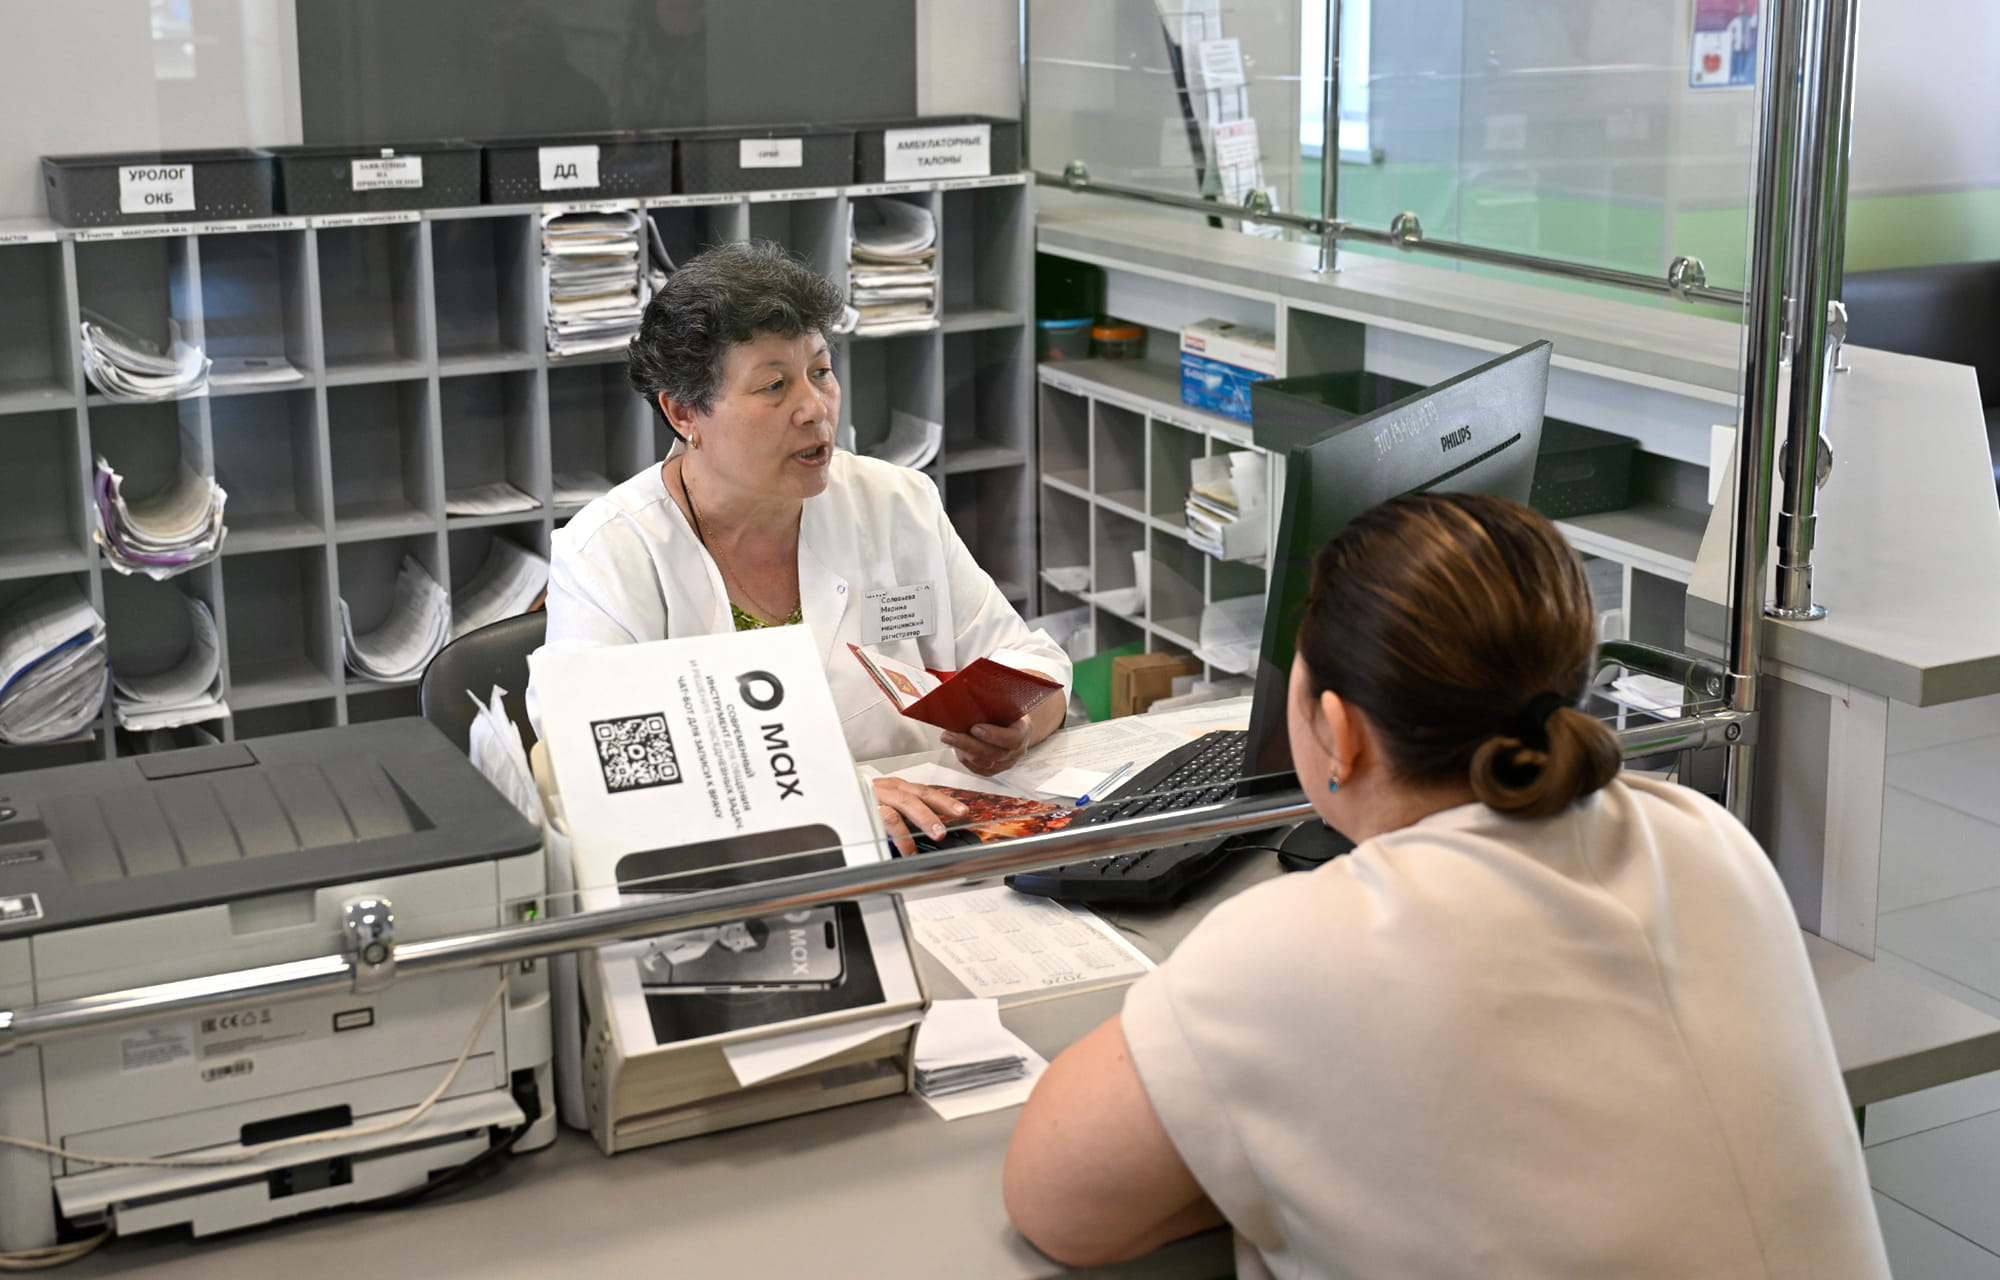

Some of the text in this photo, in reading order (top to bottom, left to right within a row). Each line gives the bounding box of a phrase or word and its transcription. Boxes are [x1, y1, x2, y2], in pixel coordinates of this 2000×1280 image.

[897, 137, 981, 150] АМБУЛАТОРНЫЕ
[918, 156, 962, 166] ТАЛОНЫ
[129, 168, 186, 181] УРОЛОГ
[554, 163, 578, 179] ДД
[144, 193, 174, 205] ОКБ
[1440, 425, 1472, 453] PHILIPS
[880, 605, 907, 613] Марина
[881, 613, 915, 623] Борисовна
[881, 619, 924, 632] медицинский
[881, 630, 921, 641] регистратор
[677, 675, 694, 715] ЧАТ-БОТ
[686, 716, 701, 737] ДЛЯ
[694, 739, 712, 780] ЗАПИСИ
[708, 789, 723, 819] ВРАЧУ
[706, 675, 731, 738] ИНСТРУМЕНТ
[730, 762, 751, 812] ОБЩЕНИЯ
[725, 703, 756, 778] СОВРЕМЕННЫЙ
[705, 715, 734, 794] ПОВСЕДНЕВНЫХ
